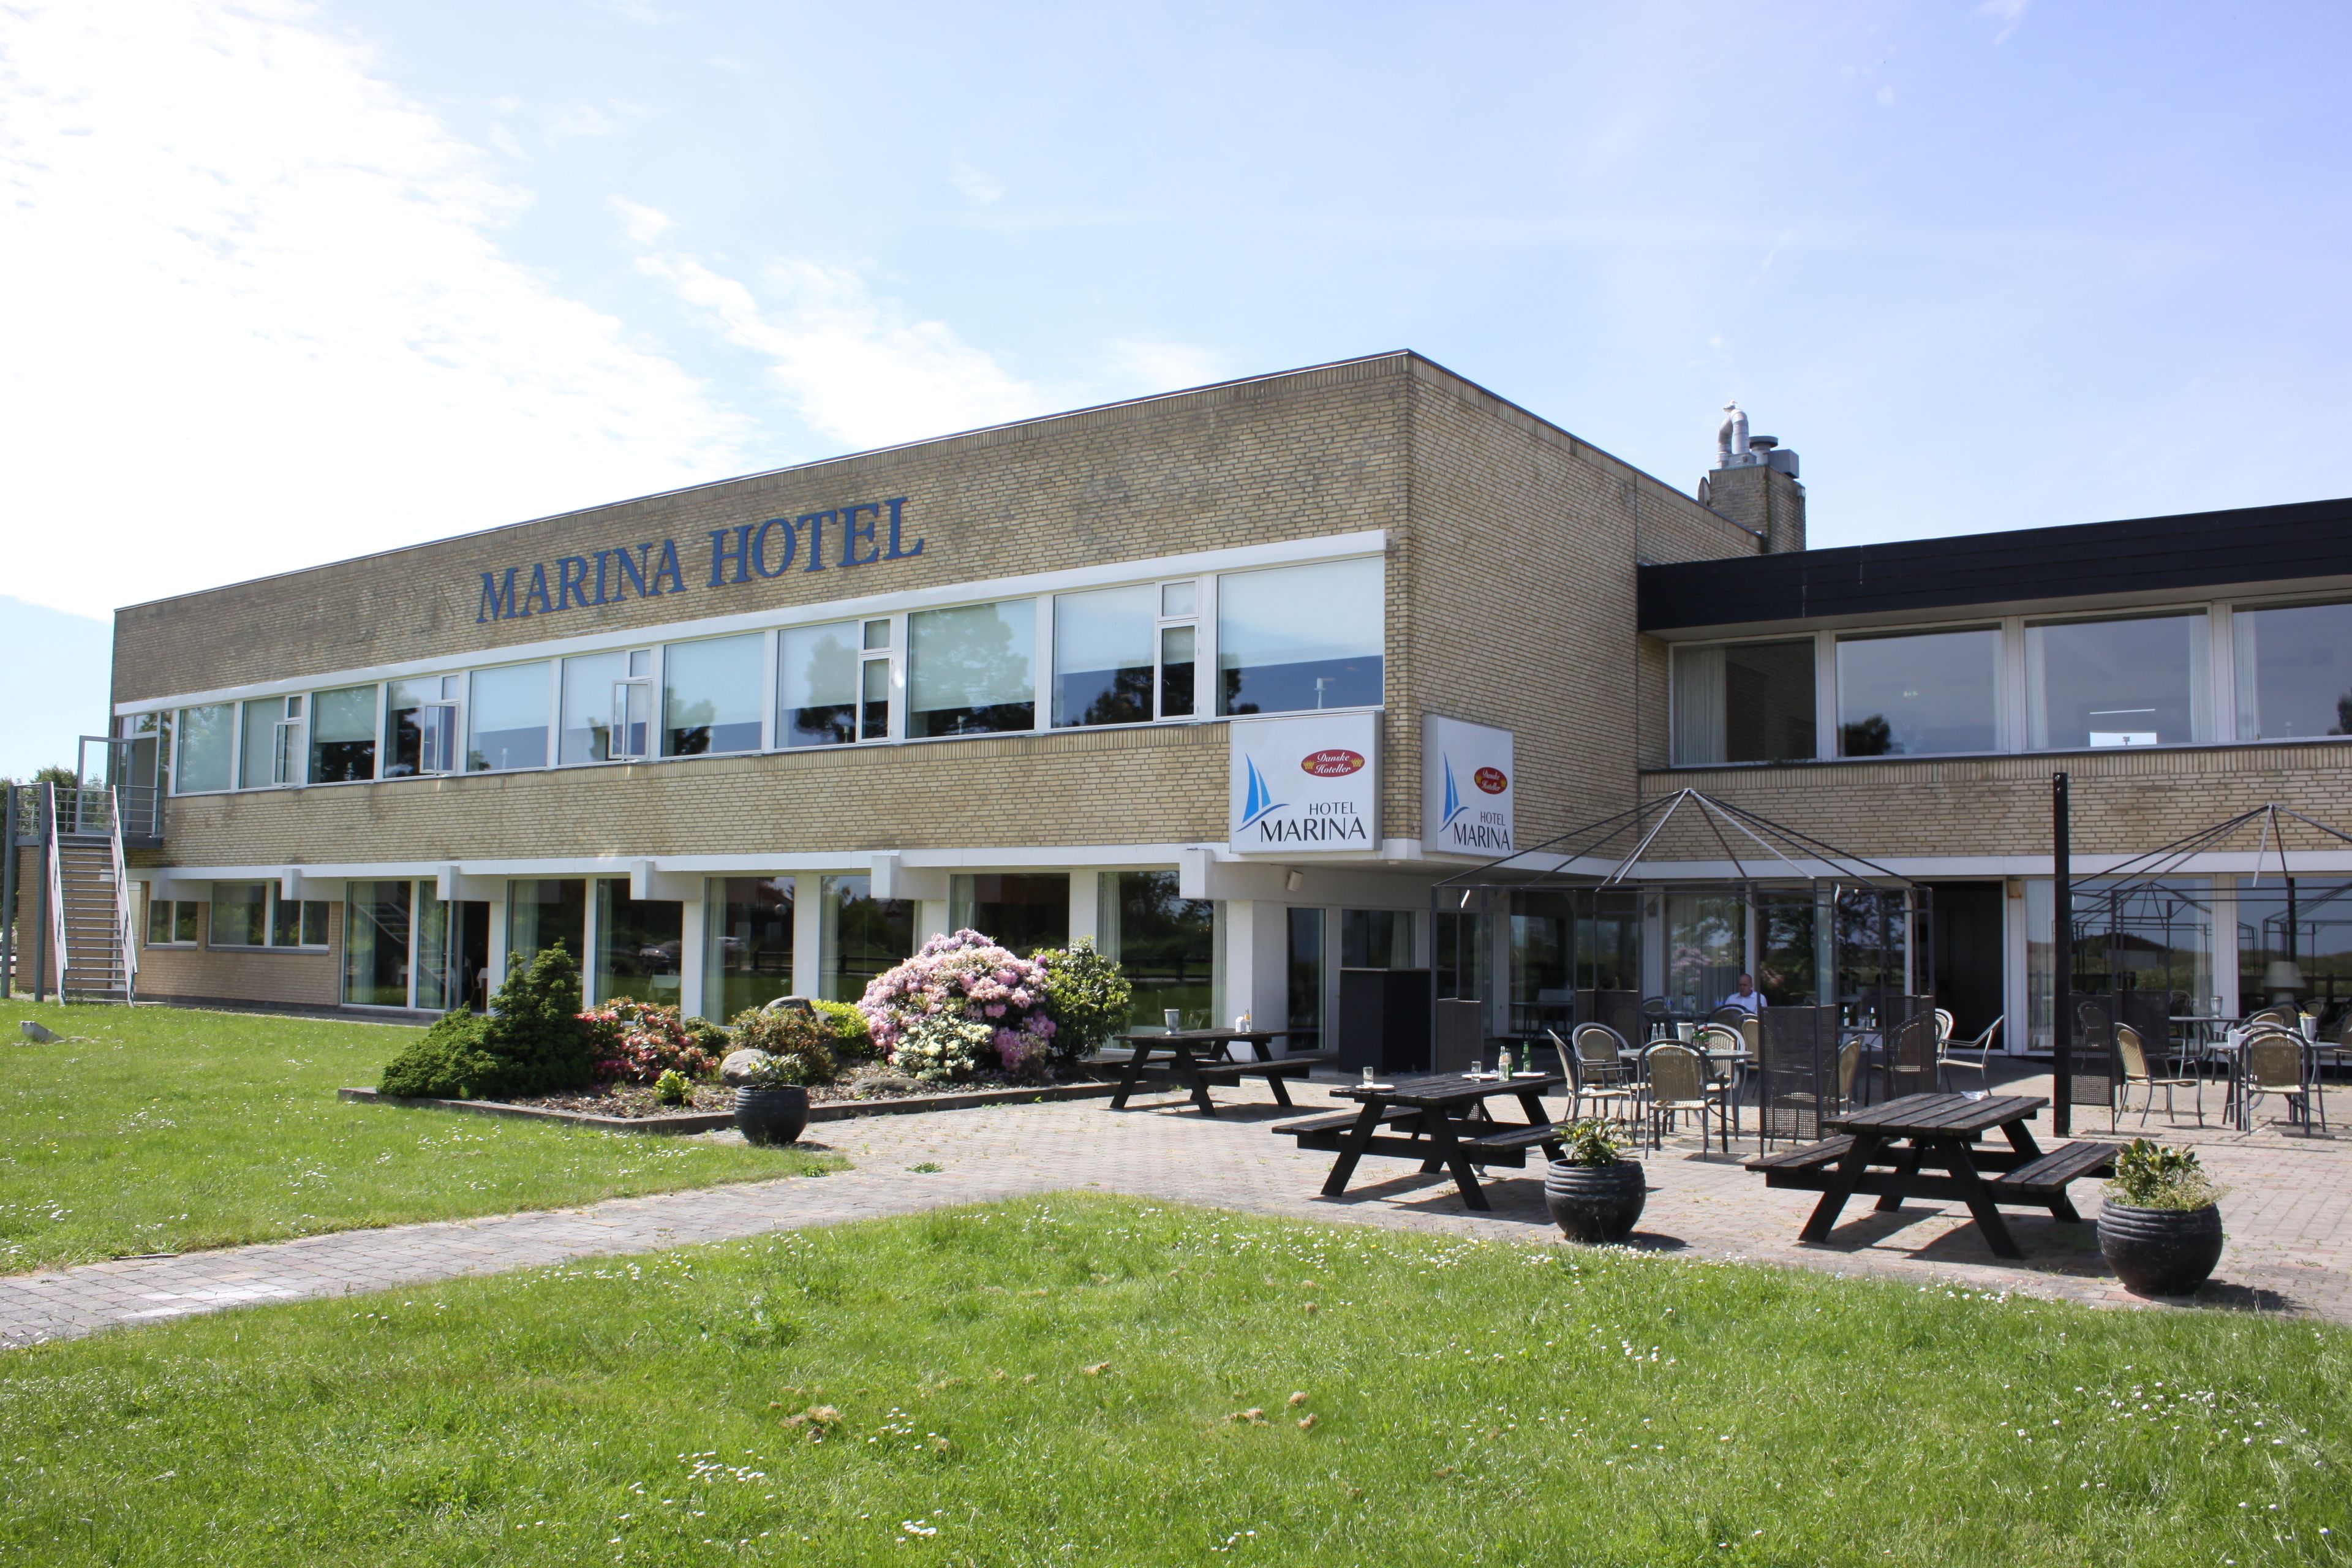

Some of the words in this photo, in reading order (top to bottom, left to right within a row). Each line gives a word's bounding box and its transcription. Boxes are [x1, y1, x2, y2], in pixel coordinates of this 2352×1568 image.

[476, 539, 687, 623] MARINA
[706, 497, 924, 587] HOTEL
[1317, 752, 1350, 763] Danske
[1314, 763, 1351, 774] Hoteller
[1310, 802, 1357, 815] HOTEL
[1480, 811, 1506, 826] HOTEL
[1261, 816, 1366, 842] MARINA
[1454, 822, 1510, 851] MARINA
